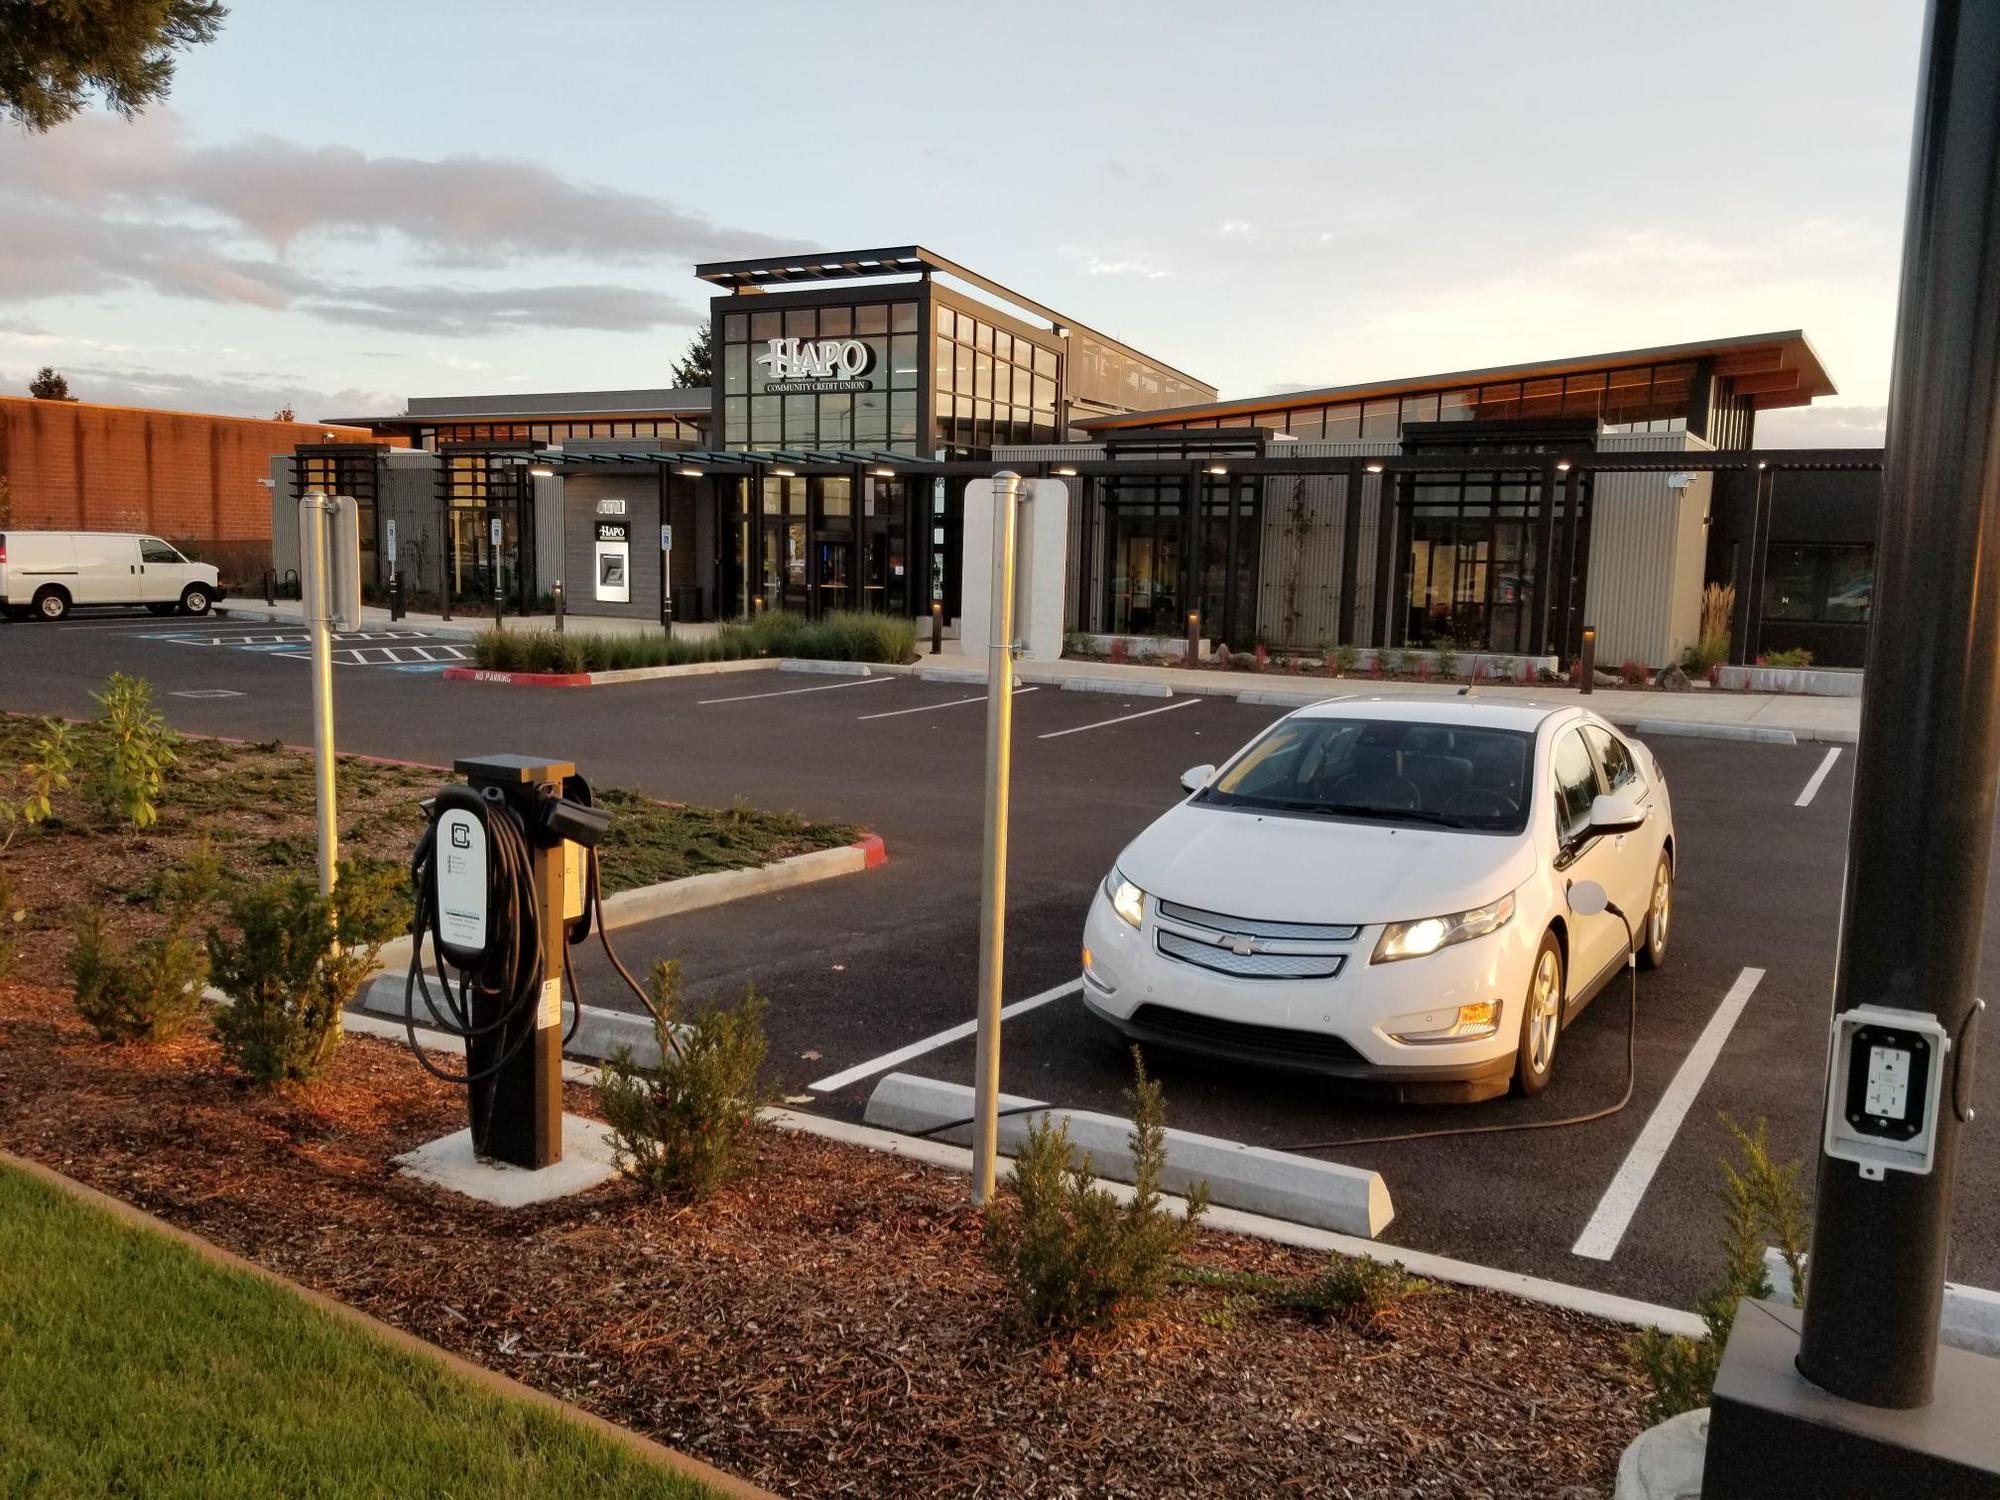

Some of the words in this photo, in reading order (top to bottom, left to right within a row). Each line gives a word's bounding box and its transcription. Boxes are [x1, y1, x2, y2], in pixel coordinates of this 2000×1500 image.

[756, 338, 868, 378] HAPO
[767, 383, 812, 392] COMMUNITY
[812, 382, 838, 391] CREDIT
[839, 381, 865, 390] UNION
[599, 525, 625, 537] HAPO
[474, 671, 484, 681] NO
[485, 671, 511, 683] PARKING
